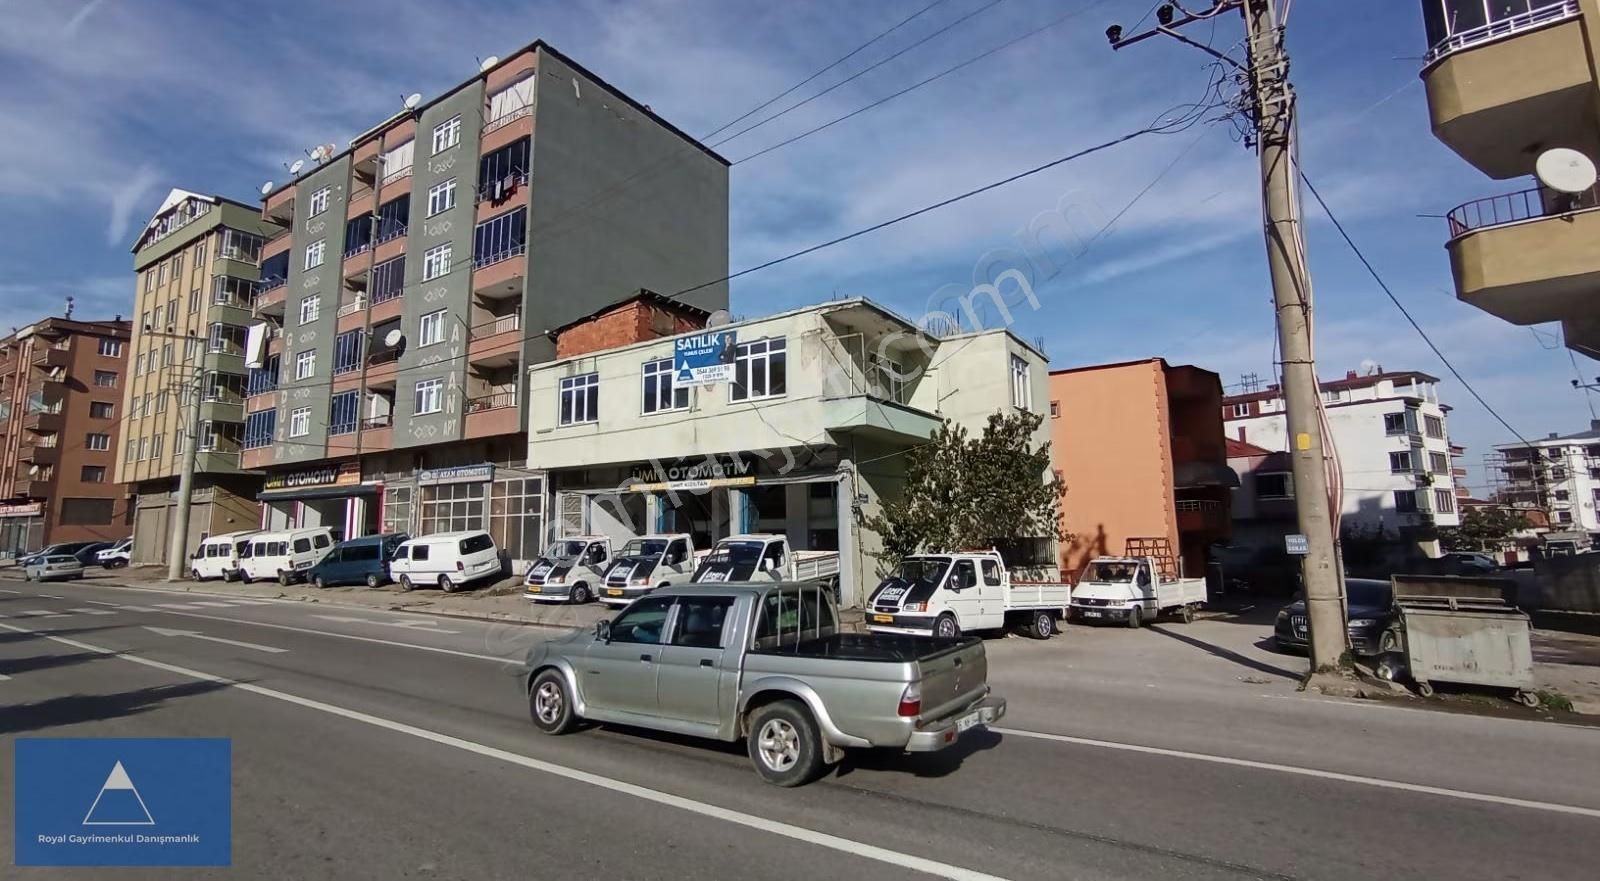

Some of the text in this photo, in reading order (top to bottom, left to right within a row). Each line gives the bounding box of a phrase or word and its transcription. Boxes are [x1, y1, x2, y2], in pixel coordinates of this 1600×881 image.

[677, 333, 720, 351] SATILIK
[446, 323, 460, 414] AYAN
[443, 419, 456, 436] APT
